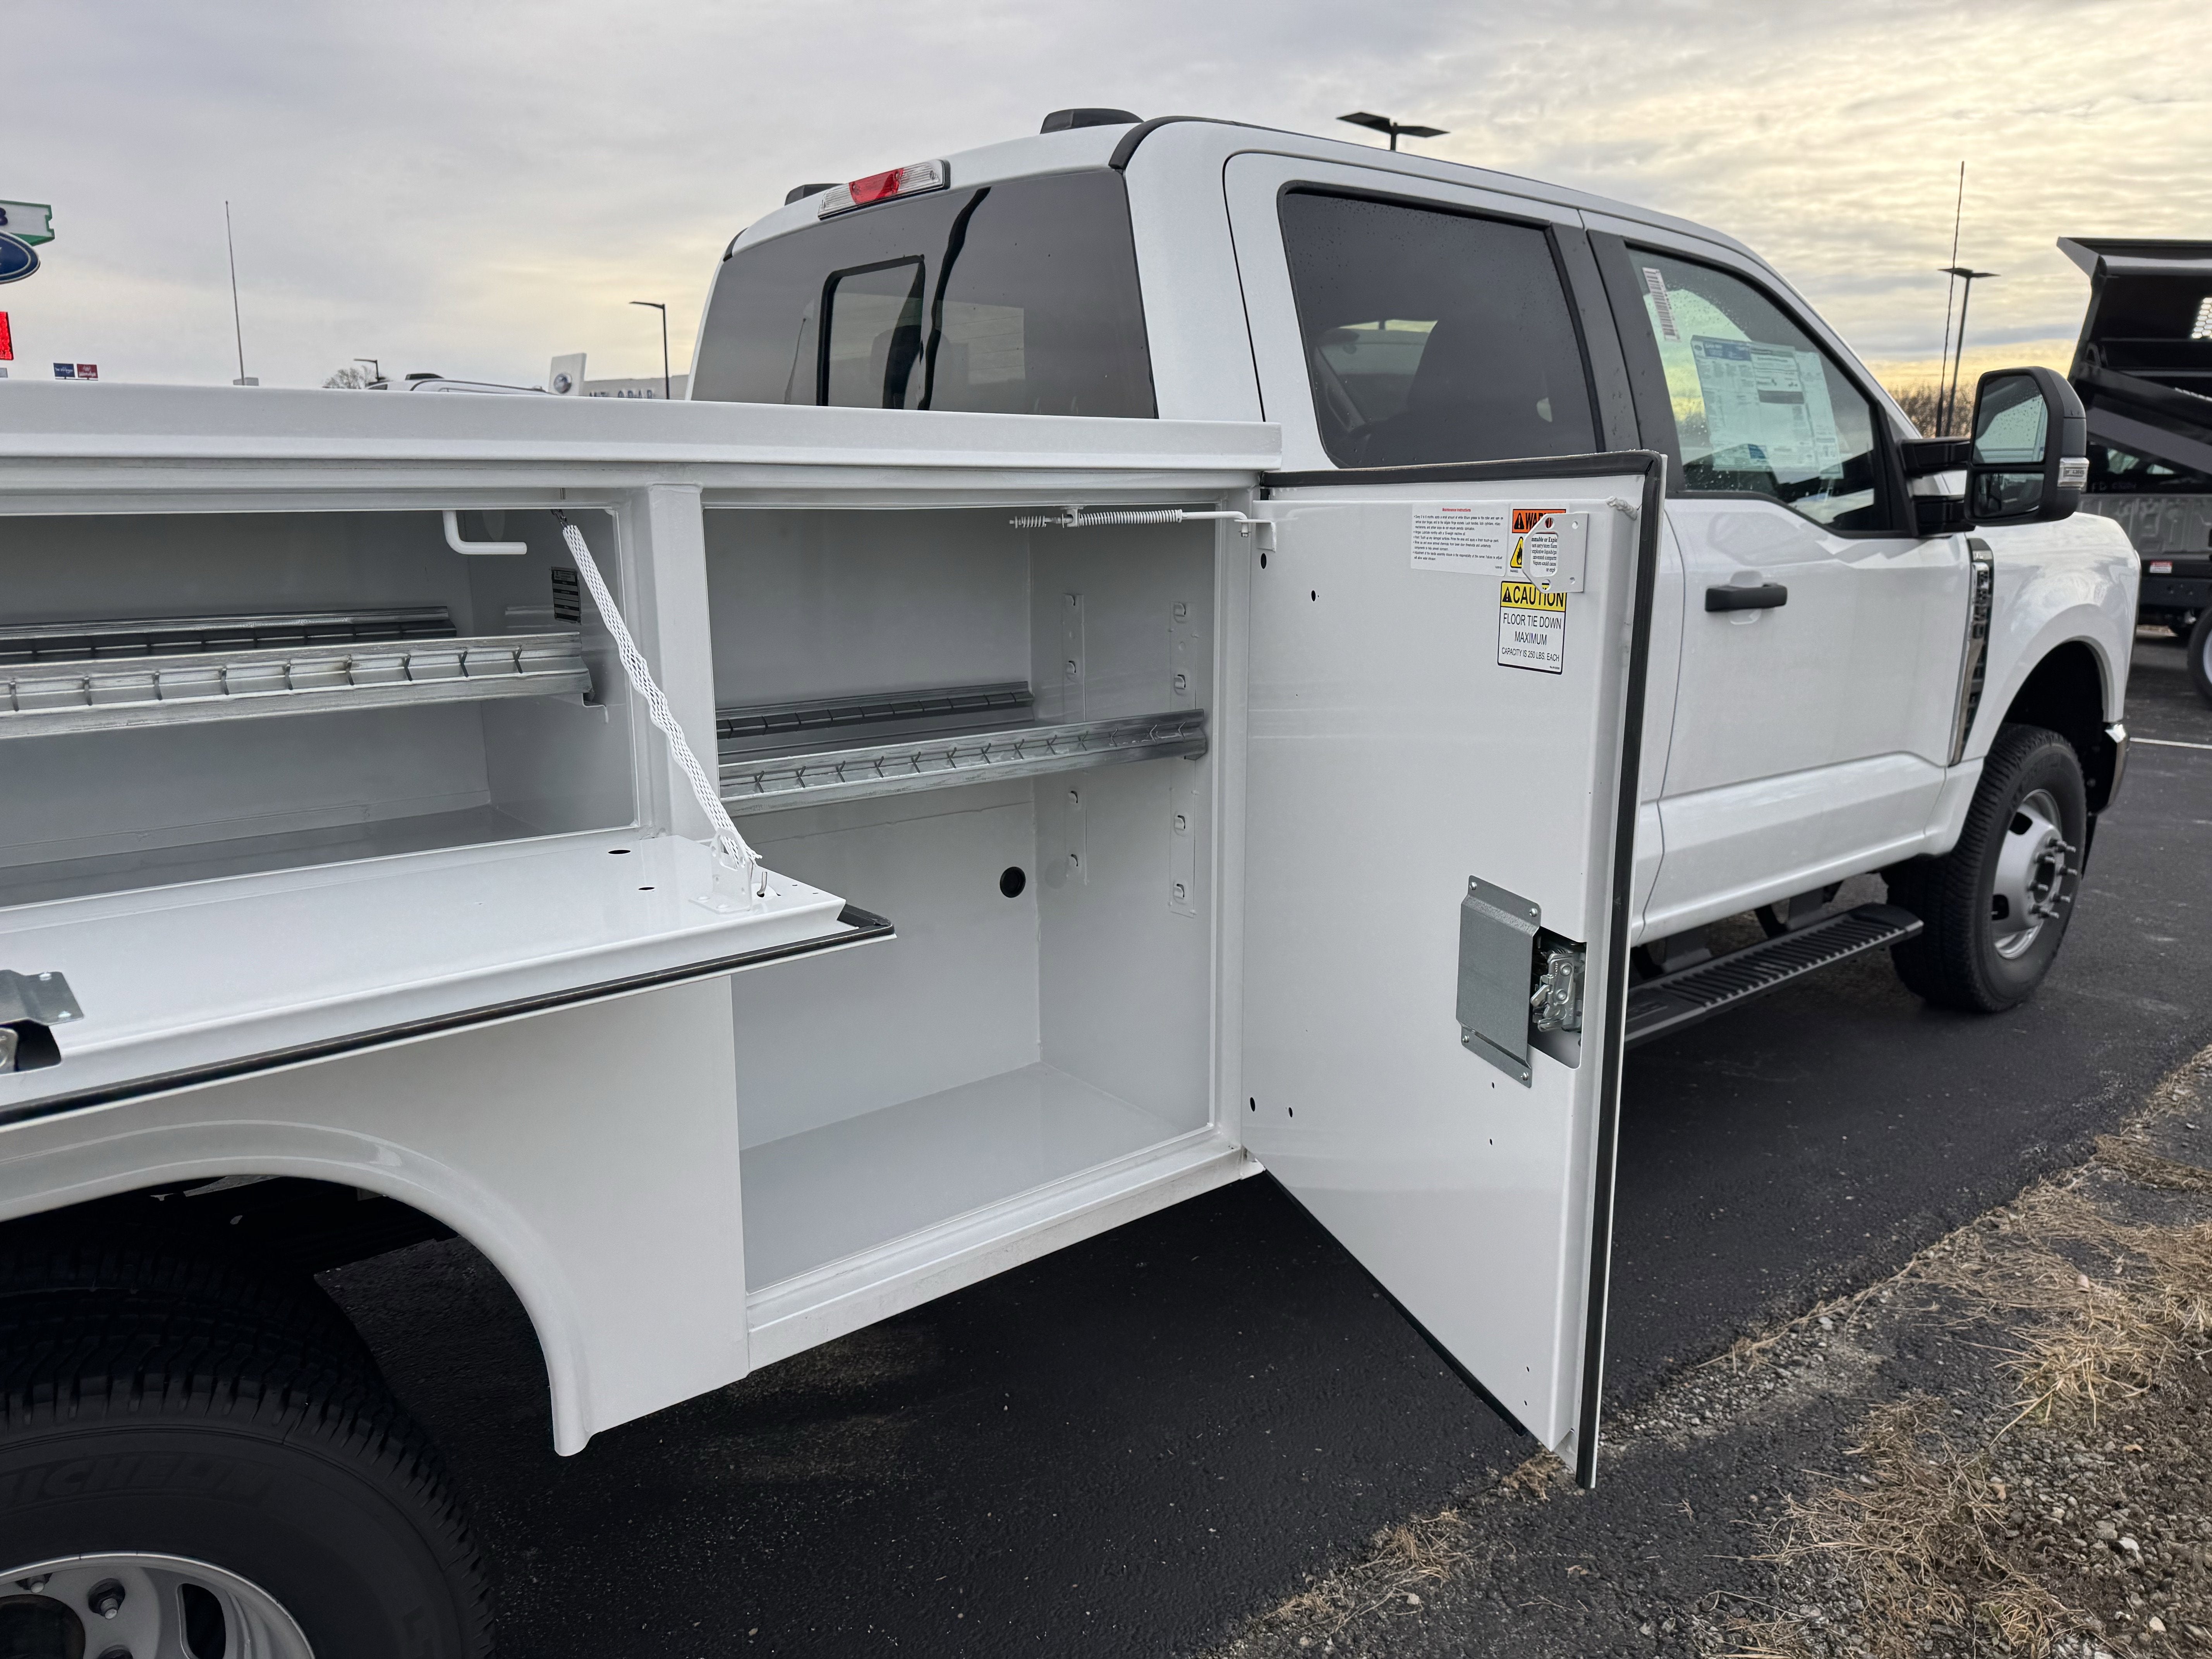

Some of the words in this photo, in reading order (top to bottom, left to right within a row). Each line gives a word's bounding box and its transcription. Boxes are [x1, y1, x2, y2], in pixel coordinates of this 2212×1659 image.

[1513, 586, 1563, 608] CAUTION
[1503, 613, 1525, 626] FLOOR
[1528, 615, 1537, 627] TIE
[1540, 617, 1561, 629] DOWN
[1515, 631, 1547, 646] MAXIMUM
[1502, 647, 1522, 657] CAPACITY
[1536, 652, 1545, 660] LBS.
[1547, 653, 1559, 662] EACH
